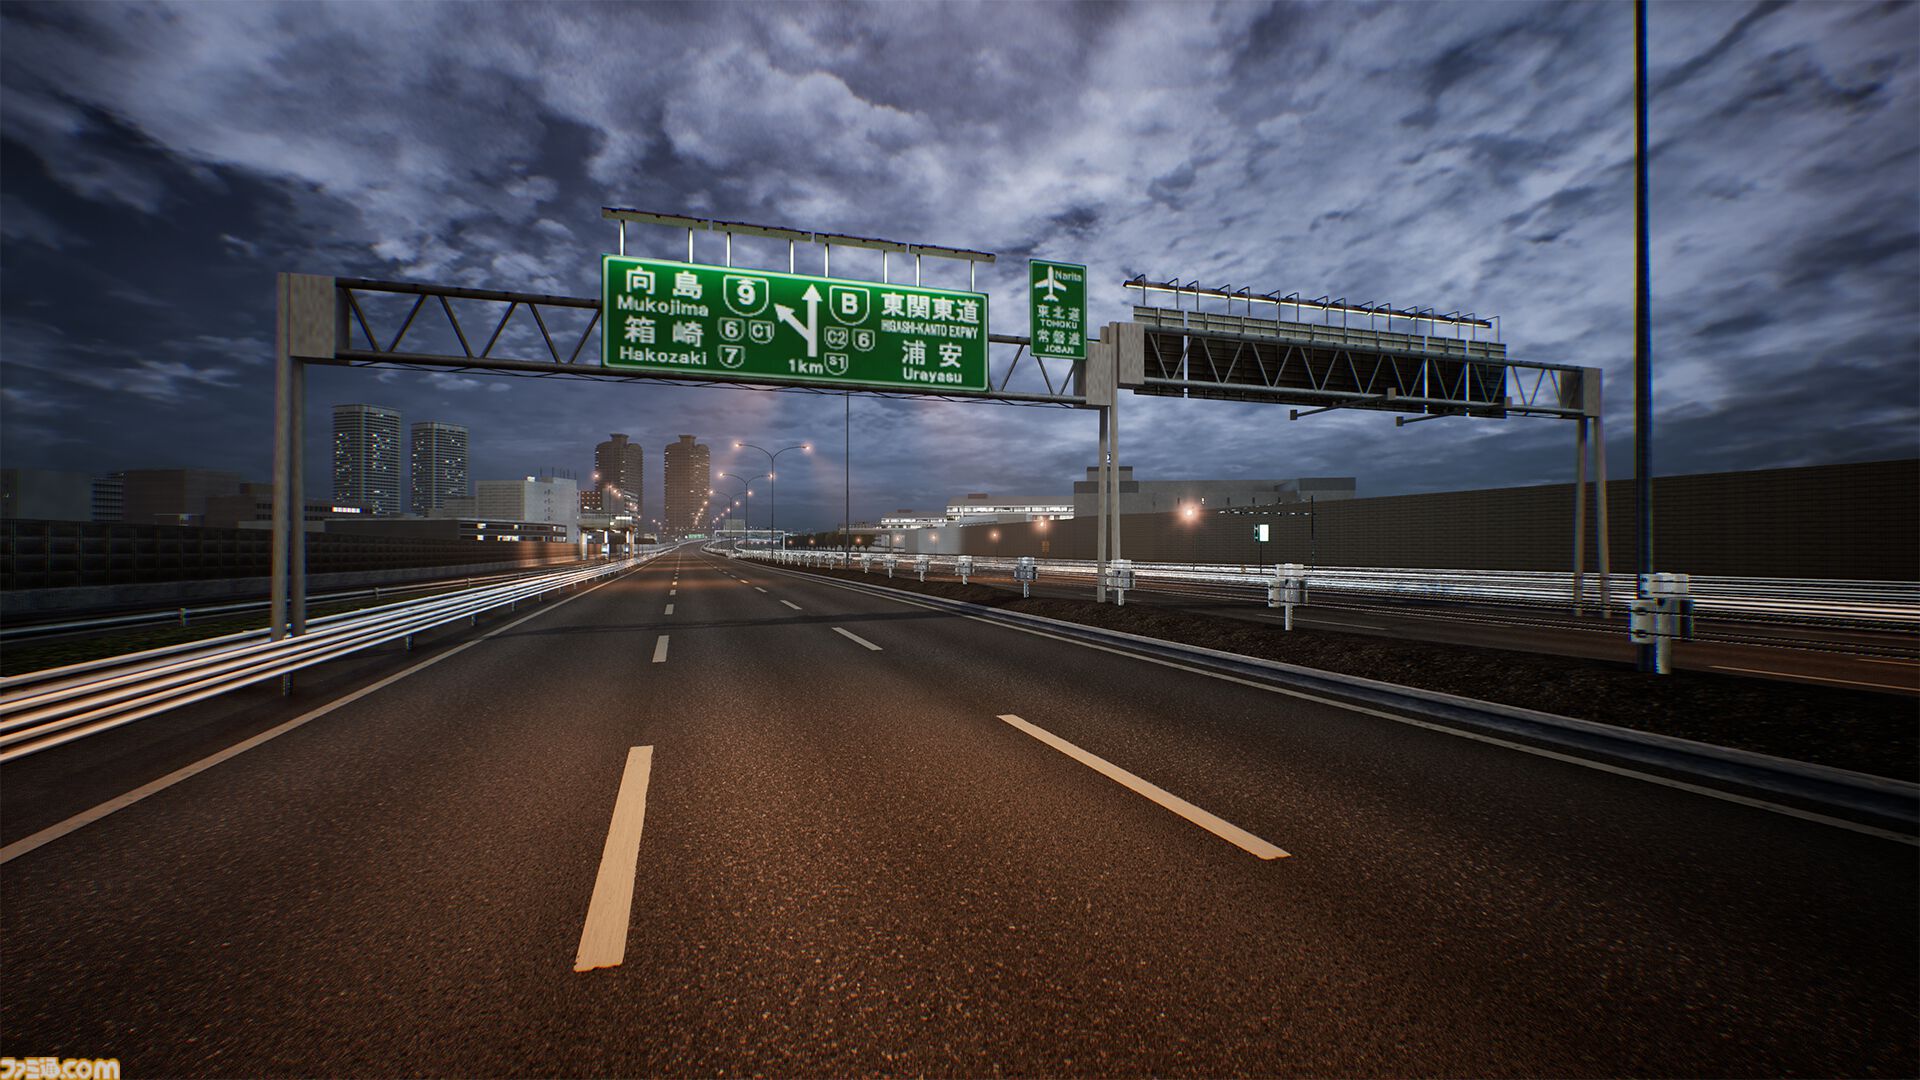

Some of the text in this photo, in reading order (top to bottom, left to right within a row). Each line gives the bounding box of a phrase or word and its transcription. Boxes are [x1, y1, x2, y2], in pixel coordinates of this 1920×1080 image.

[626, 266, 703, 299] 向島
[1055, 270, 1082, 282] Narita
[737, 283, 756, 306] 9
[841, 292, 858, 315] B
[617, 295, 709, 317] Mukojima
[881, 292, 979, 324] 東関東道
[1037, 303, 1080, 321] 東北道
[624, 315, 704, 348] 箱崎
[724, 321, 772, 341] 6 C1
[949, 325, 979, 340] EXPWY
[1040, 319, 1078, 329] TOHOKU
[826, 330, 870, 347] C2 6
[619, 346, 707, 366] Hakozaki
[724, 348, 738, 364] 7
[902, 339, 963, 368] 浦安
[1045, 345, 1074, 354] JOBAN
[788, 358, 824, 375] 1km
[903, 367, 963, 384] Urayasu
